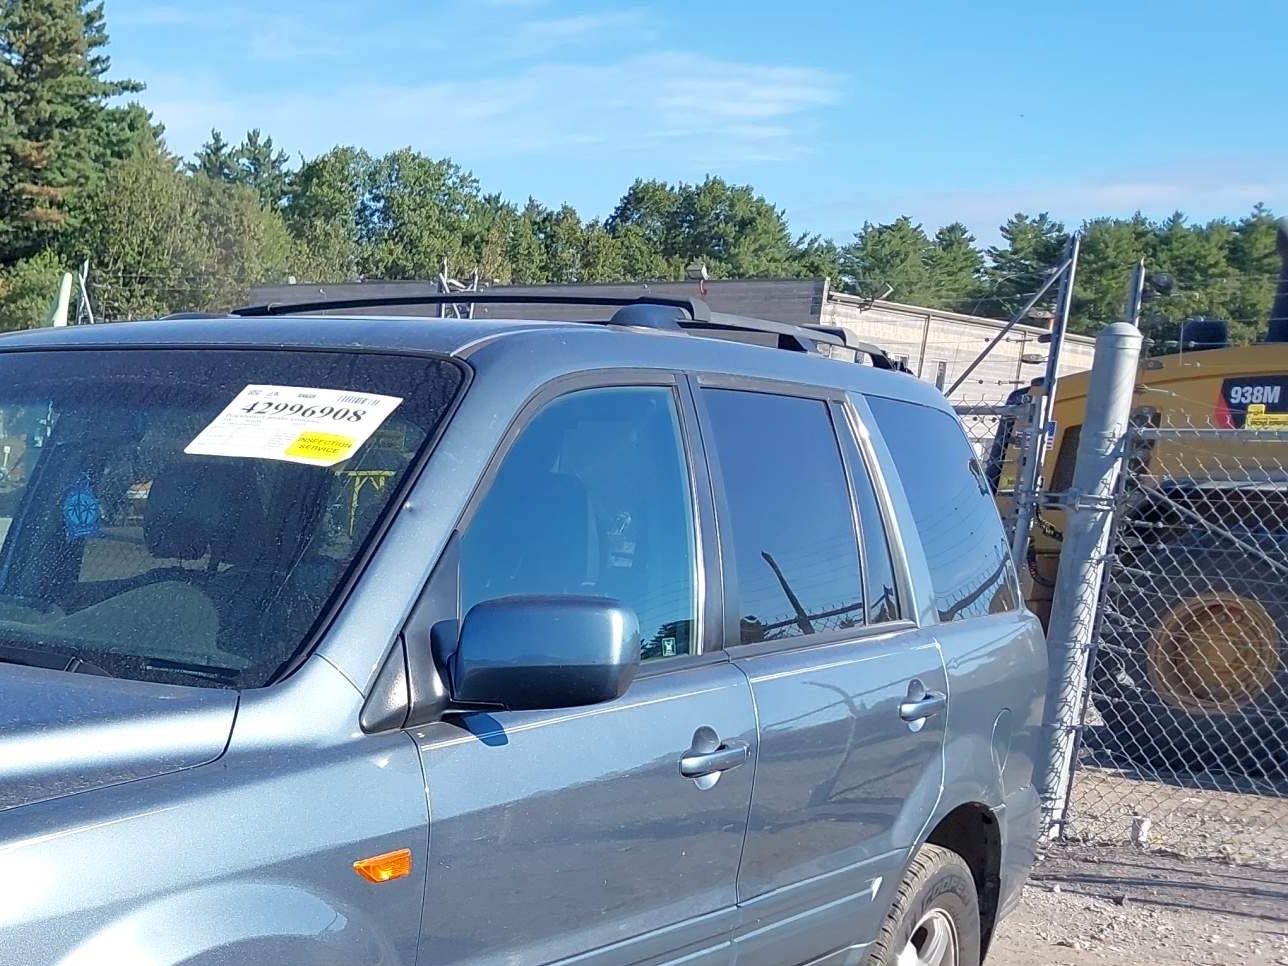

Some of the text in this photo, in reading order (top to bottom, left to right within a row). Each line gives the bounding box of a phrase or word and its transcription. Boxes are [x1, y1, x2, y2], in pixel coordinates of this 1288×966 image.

[1230, 386, 1281, 404] 938M
[241, 401, 368, 423] 42996908
[297, 437, 353, 449] INSPECTION
[298, 443, 340, 454] SERVICE
